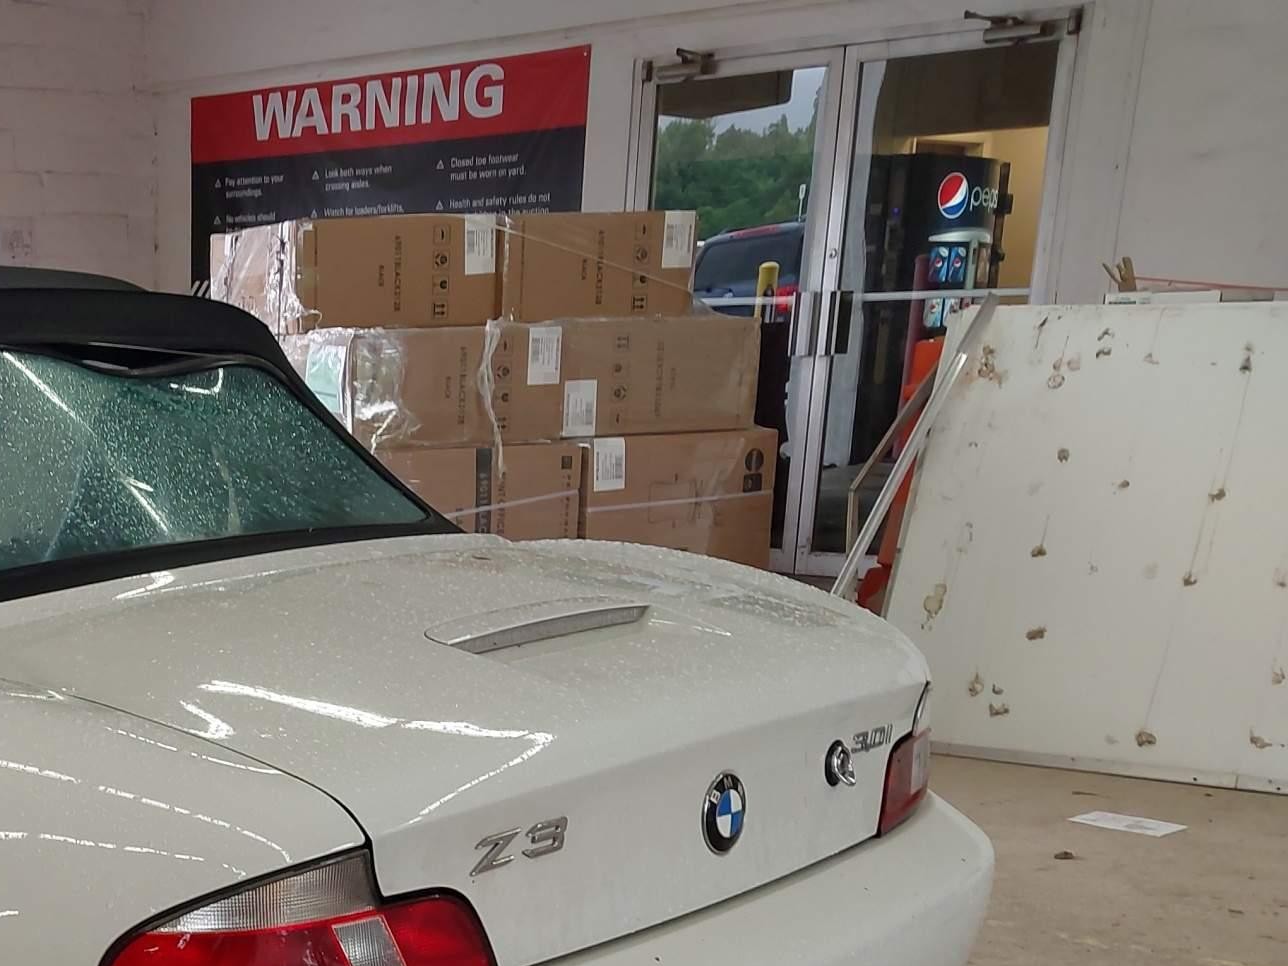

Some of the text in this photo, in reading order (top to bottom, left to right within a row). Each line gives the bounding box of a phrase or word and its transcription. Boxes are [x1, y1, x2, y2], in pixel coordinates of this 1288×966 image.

[252, 63, 505, 142] WARNING
[450, 156, 474, 169] Closed
[450, 170, 467, 181] must
[469, 169, 478, 180] be
[479, 169, 497, 178] worn
[969, 186, 999, 213] peps
[469, 816, 569, 877] Z3
